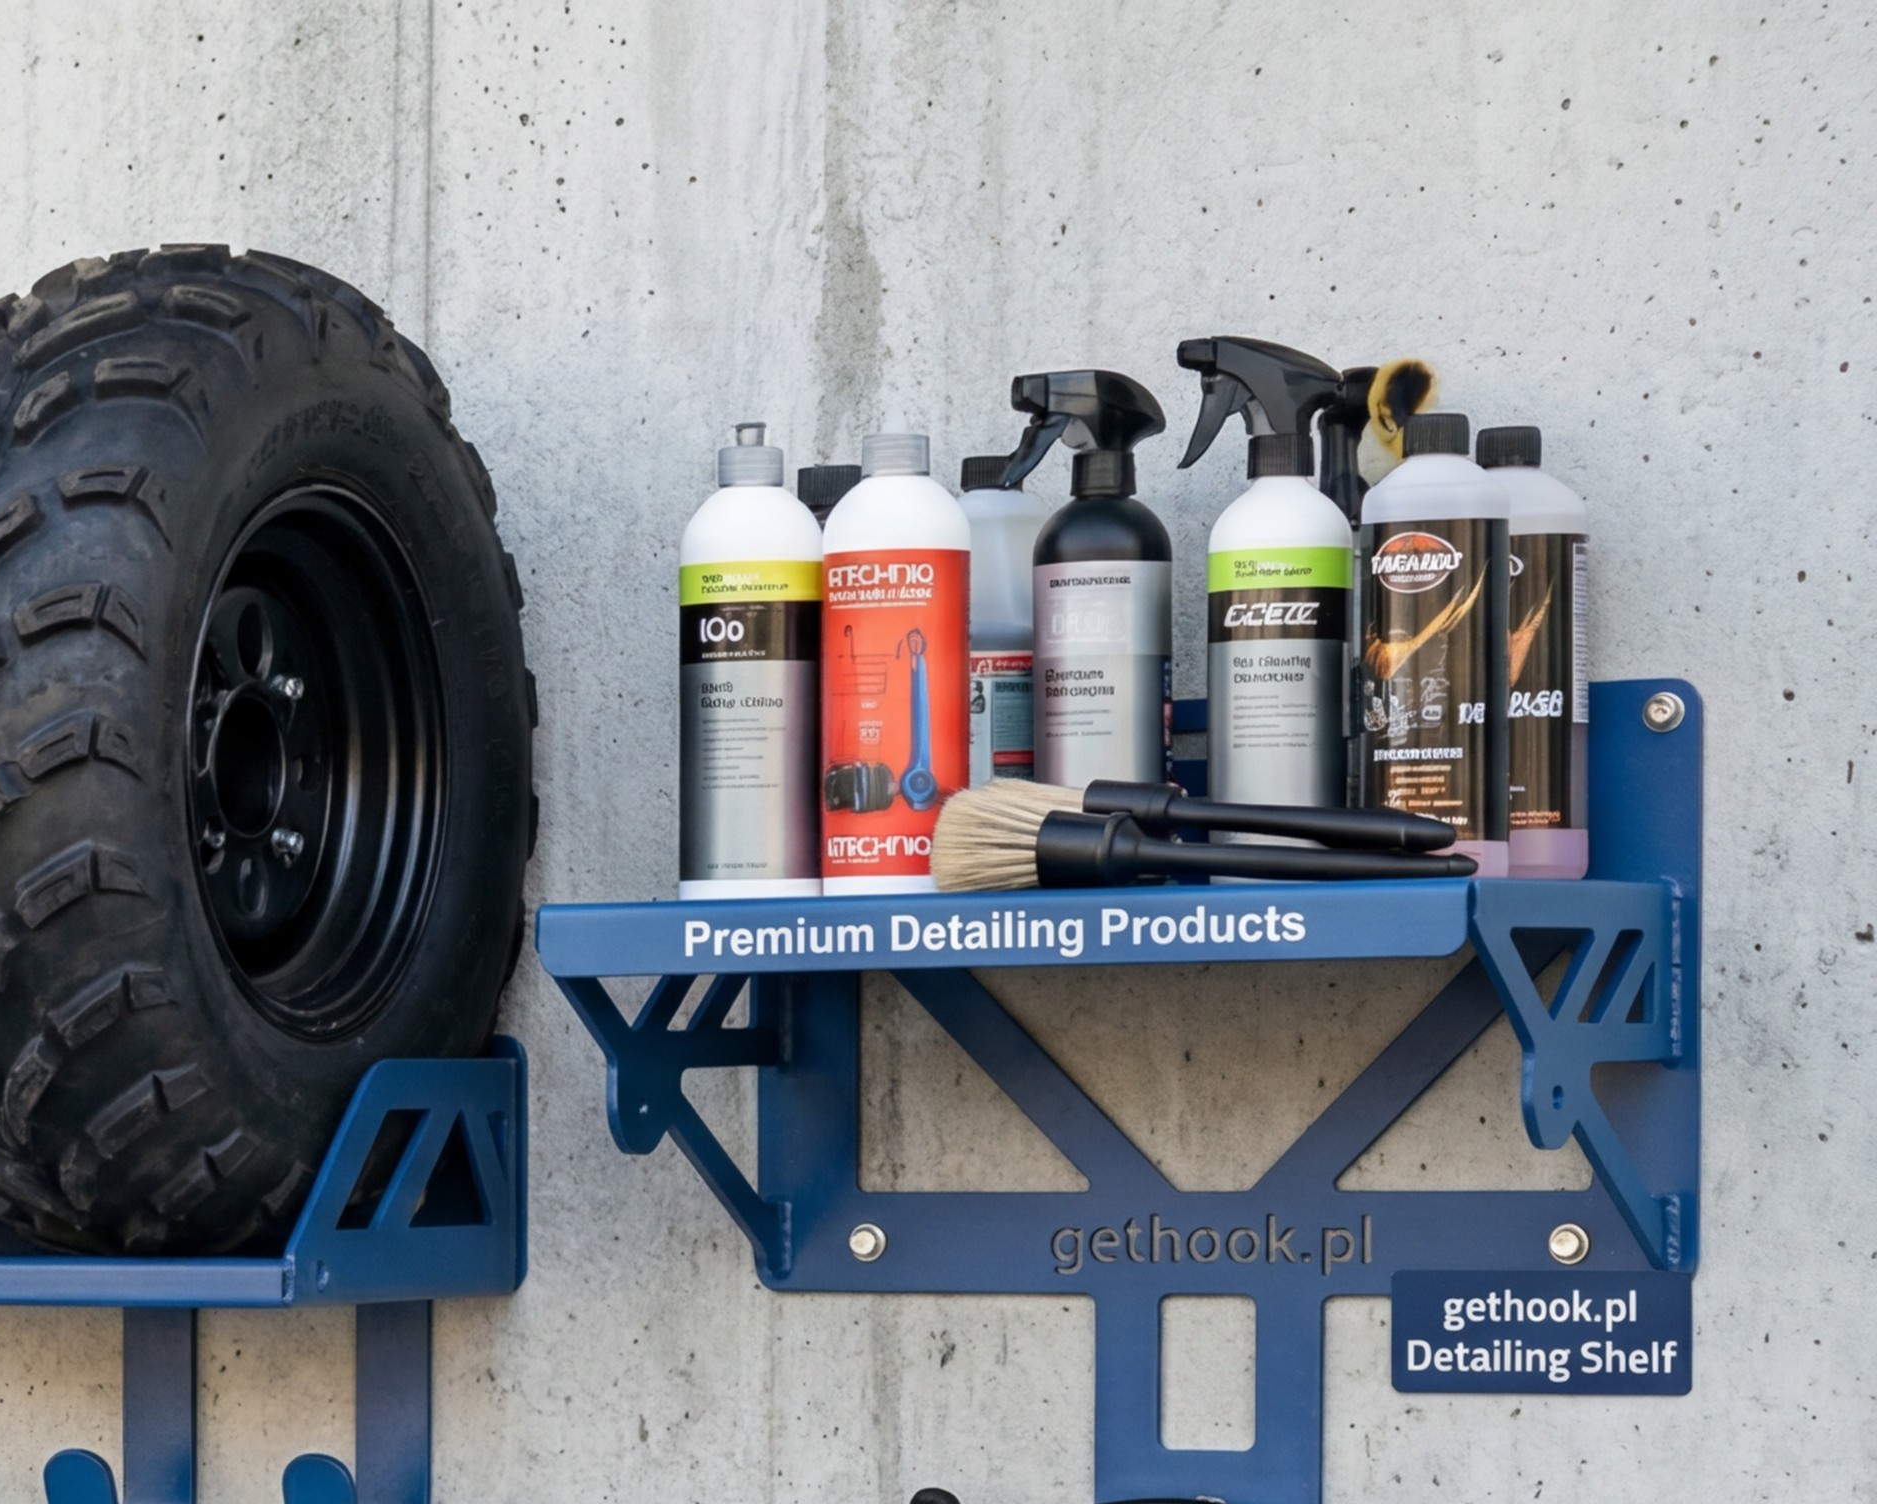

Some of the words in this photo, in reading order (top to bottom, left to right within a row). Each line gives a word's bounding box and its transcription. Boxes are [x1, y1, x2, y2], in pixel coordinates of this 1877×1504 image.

[684, 917, 874, 957] Premium
[890, 910, 1084, 958] Detailing
[1101, 905, 1306, 946] Products
[1051, 1213, 1373, 1277] gethook.pl
[1443, 1289, 1637, 1333] gethook.pl
[1407, 1339, 1571, 1383] Detailing
[1580, 1340, 1678, 1374] Shelf
